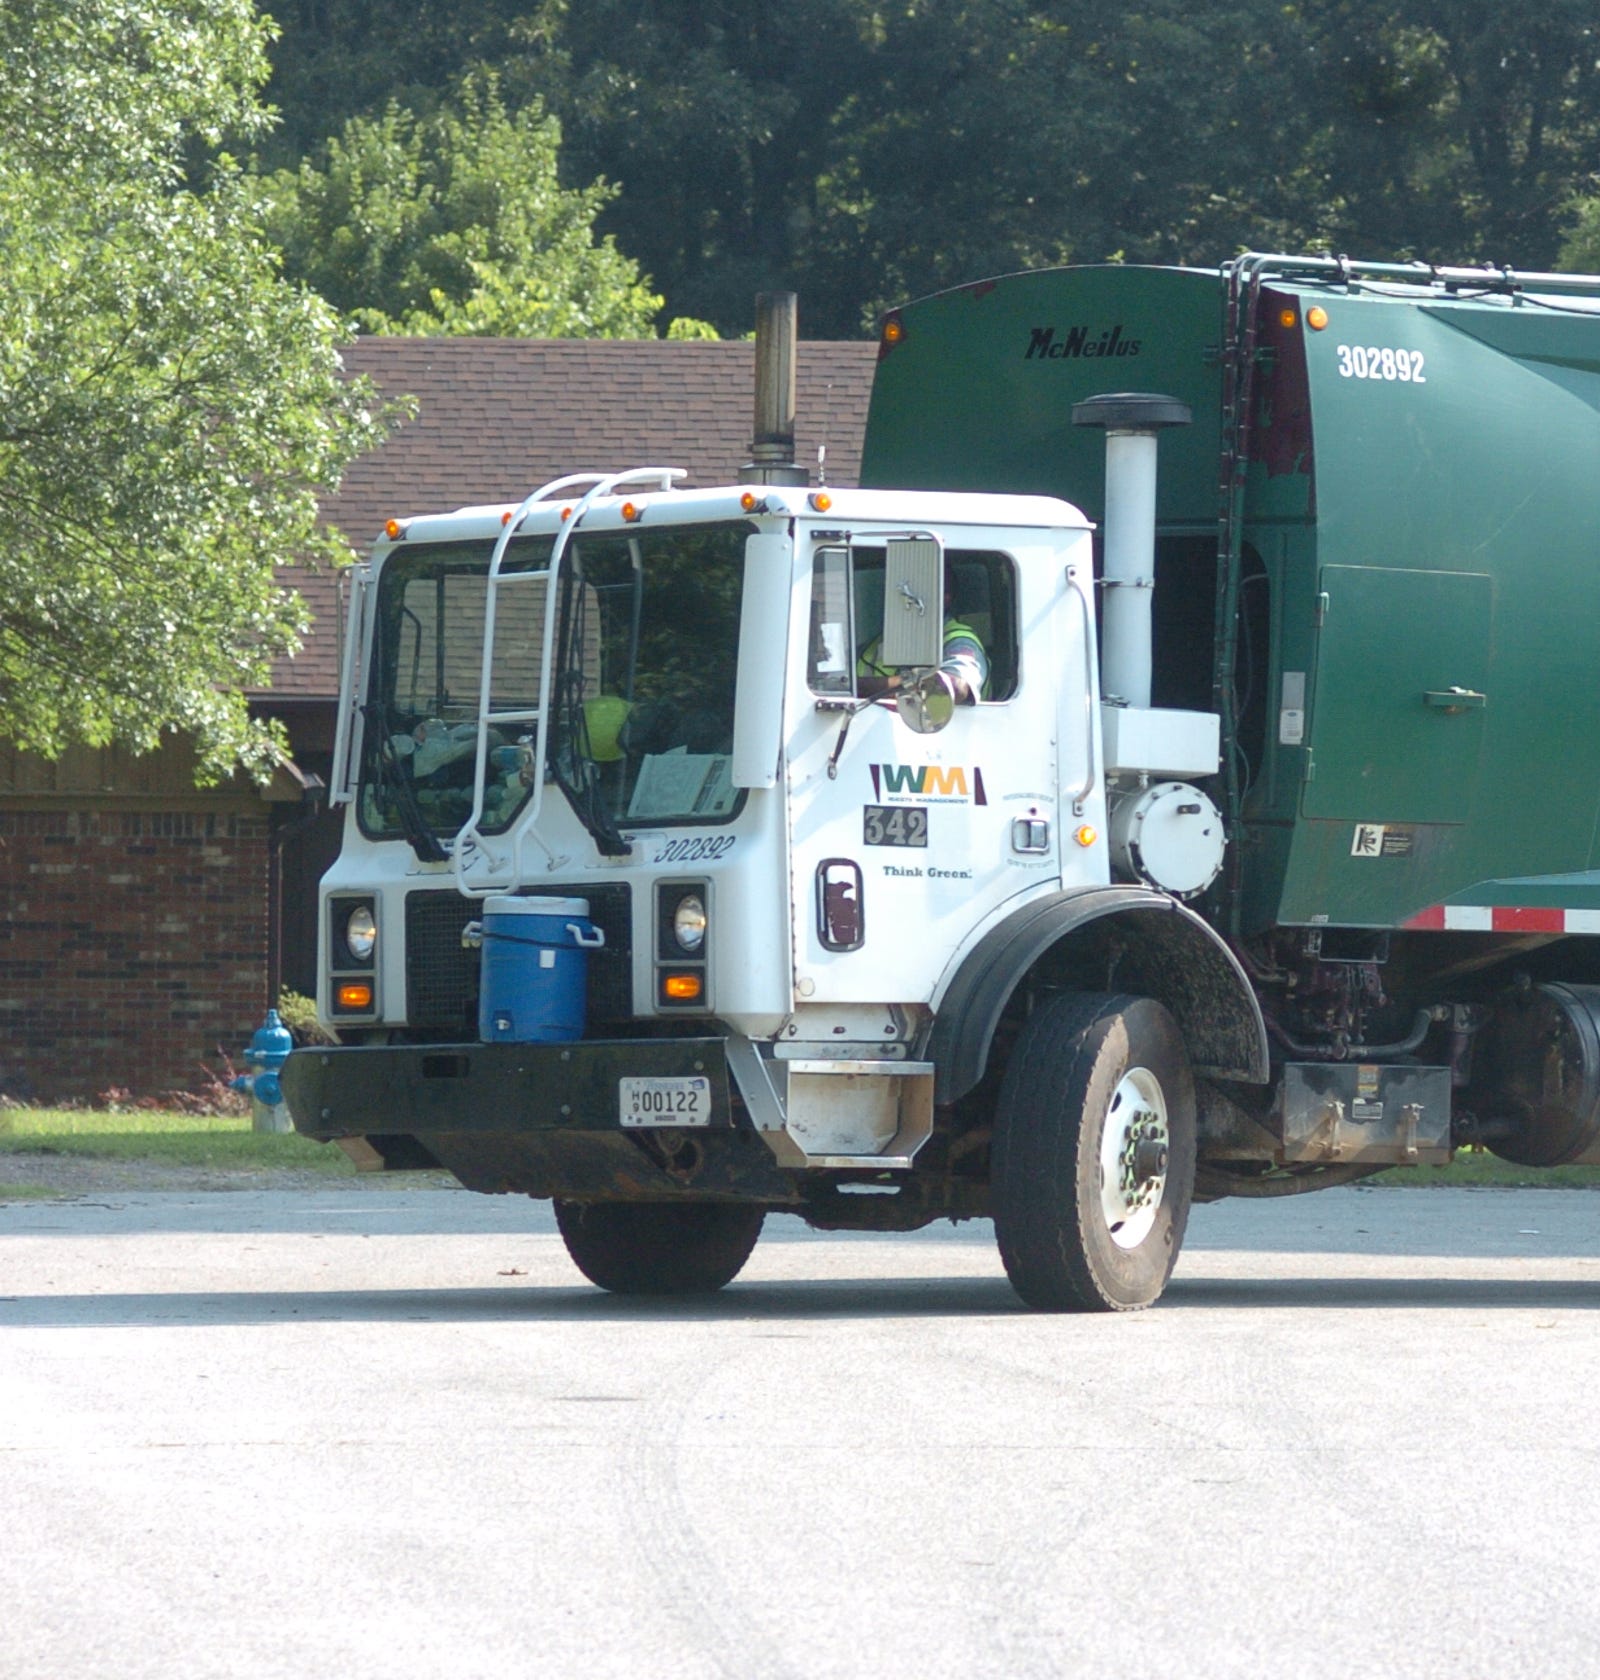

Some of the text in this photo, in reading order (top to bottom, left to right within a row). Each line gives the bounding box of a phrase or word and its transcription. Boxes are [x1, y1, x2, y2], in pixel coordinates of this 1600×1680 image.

[1025, 326, 1141, 359] McNeilus
[1337, 344, 1426, 383] 302892
[882, 763, 969, 796] WM
[865, 807, 927, 846] 342
[653, 835, 736, 863] 302892
[883, 866, 973, 879] Think Green.
[642, 1090, 699, 1112] 00122
